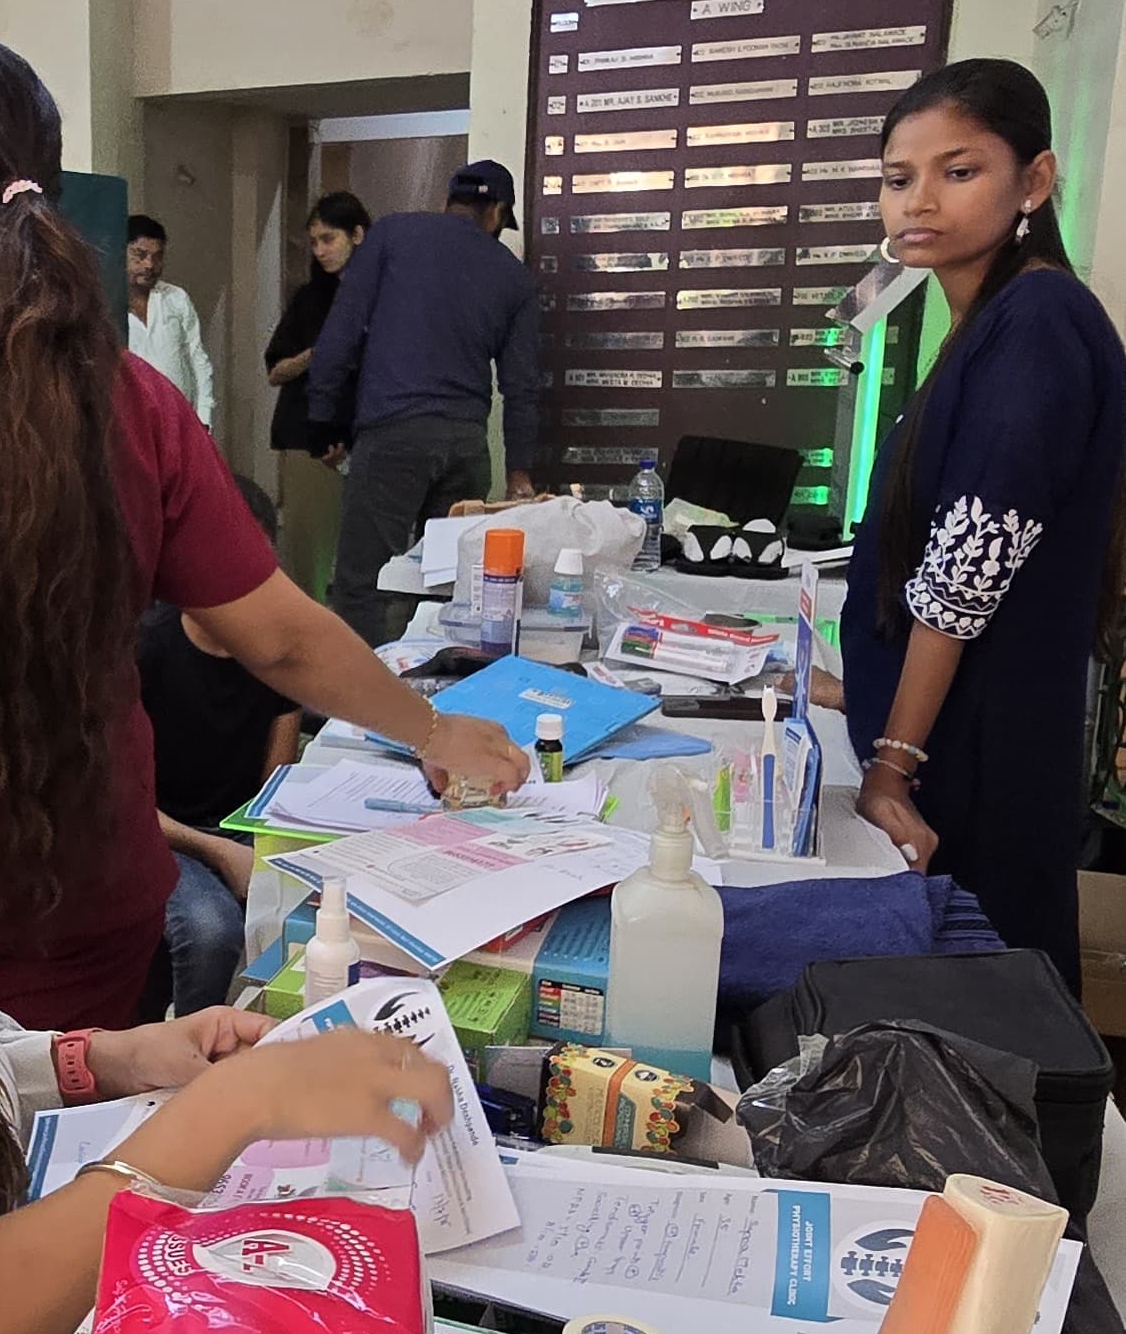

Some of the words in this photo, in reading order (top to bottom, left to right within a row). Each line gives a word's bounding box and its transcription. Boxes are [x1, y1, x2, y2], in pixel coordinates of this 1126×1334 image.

[702, 3, 712, 15] A
[718, 0, 752, 13] WING
[790, 1205, 799, 1275] PHYSIOTHERAPY
[805, 1221, 813, 1247] JOINT
[802, 1249, 812, 1281] EFFORT
[788, 1278, 797, 1305] CLINIC
